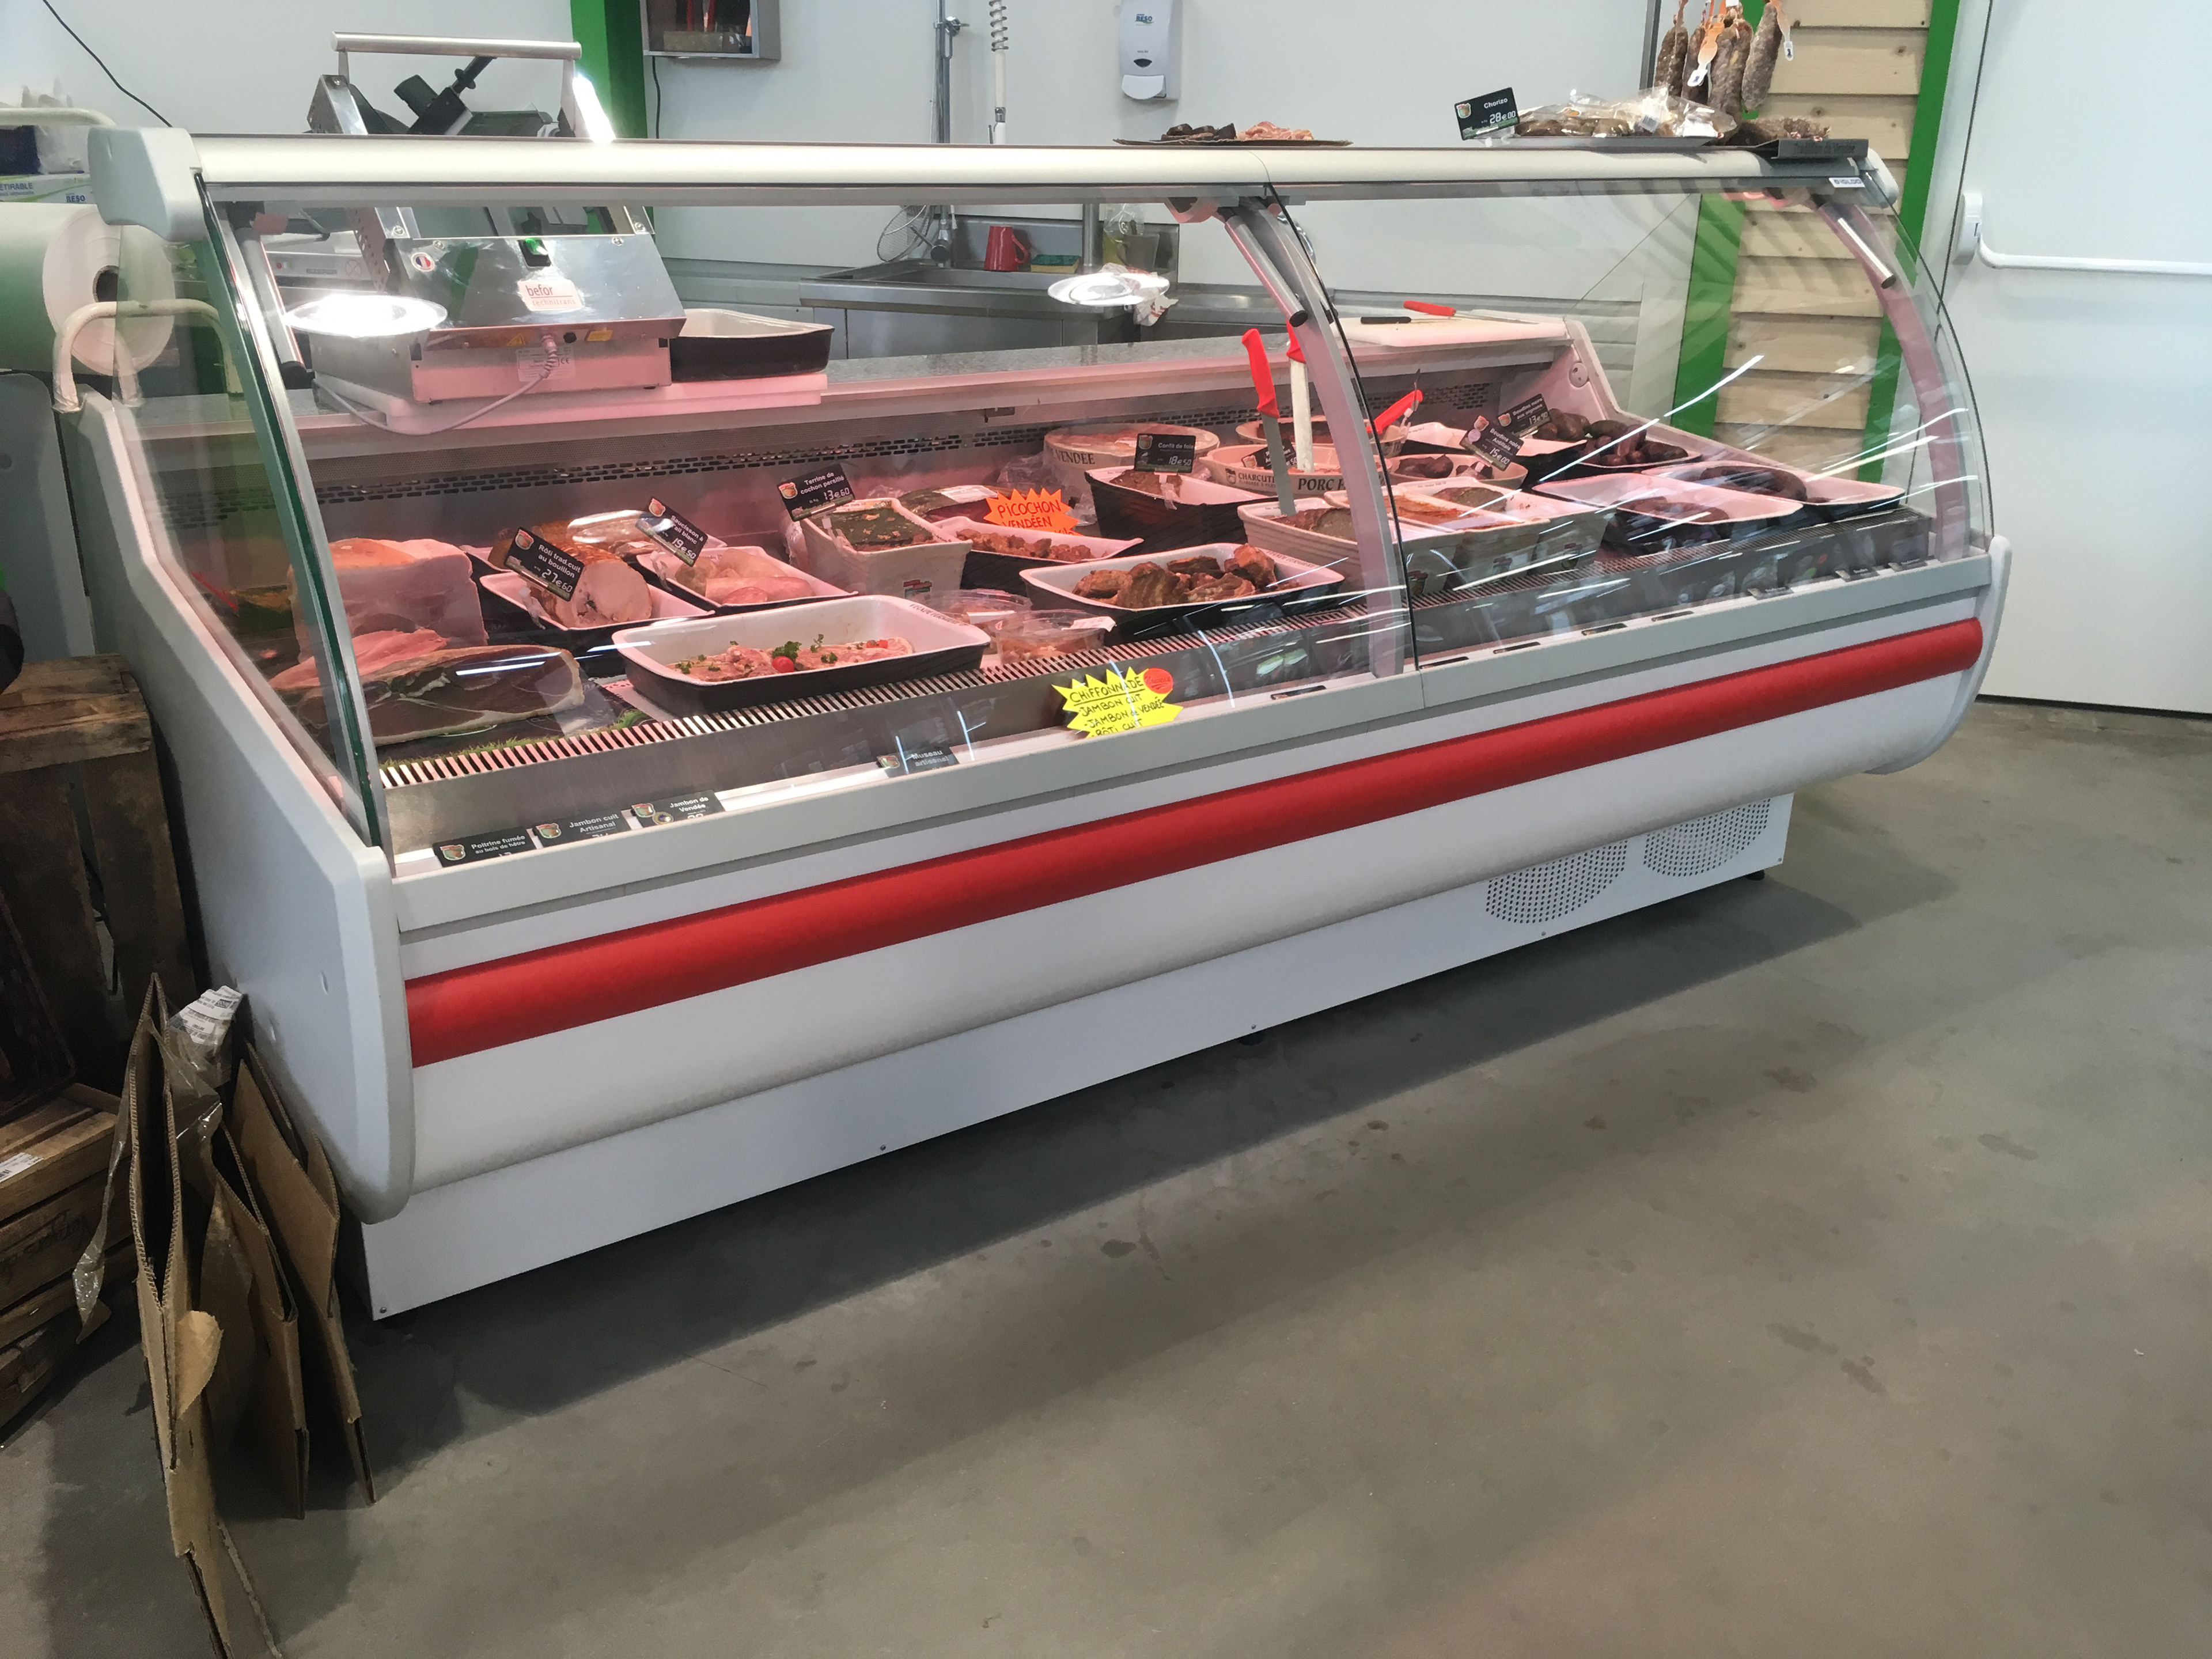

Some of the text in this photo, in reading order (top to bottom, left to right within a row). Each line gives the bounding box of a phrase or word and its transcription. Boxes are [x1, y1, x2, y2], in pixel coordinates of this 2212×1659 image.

[1484, 98, 1508, 109] Chorizo
[525, 284, 553, 296] befor
[1490, 428, 1521, 449] Boudins noirs
[1493, 437, 1511, 451] Antillais
[804, 475, 825, 485] Terrine
[1298, 478, 1335, 491] PORC
[801, 484, 823, 494] cochon
[671, 515, 699, 539] Saucisson
[1002, 515, 1052, 529] VENDÉEN
[682, 531, 698, 544] blanc
[539, 544, 553, 556] Rôti
[538, 554, 547, 562] au
[548, 559, 575, 578] bouillon
[1139, 696, 1165, 714] VENDÉE
[912, 750, 944, 759] Museau
[915, 756, 949, 767] artisanal
[670, 800, 698, 808] Jambon
[679, 803, 706, 812] Vendée
[569, 813, 619, 828] Jambon cuit
[579, 821, 616, 833] Artisanal
[471, 834, 526, 850] Poitrine fumée
[484, 845, 499, 853] bois
[508, 840, 525, 849] hêtre
